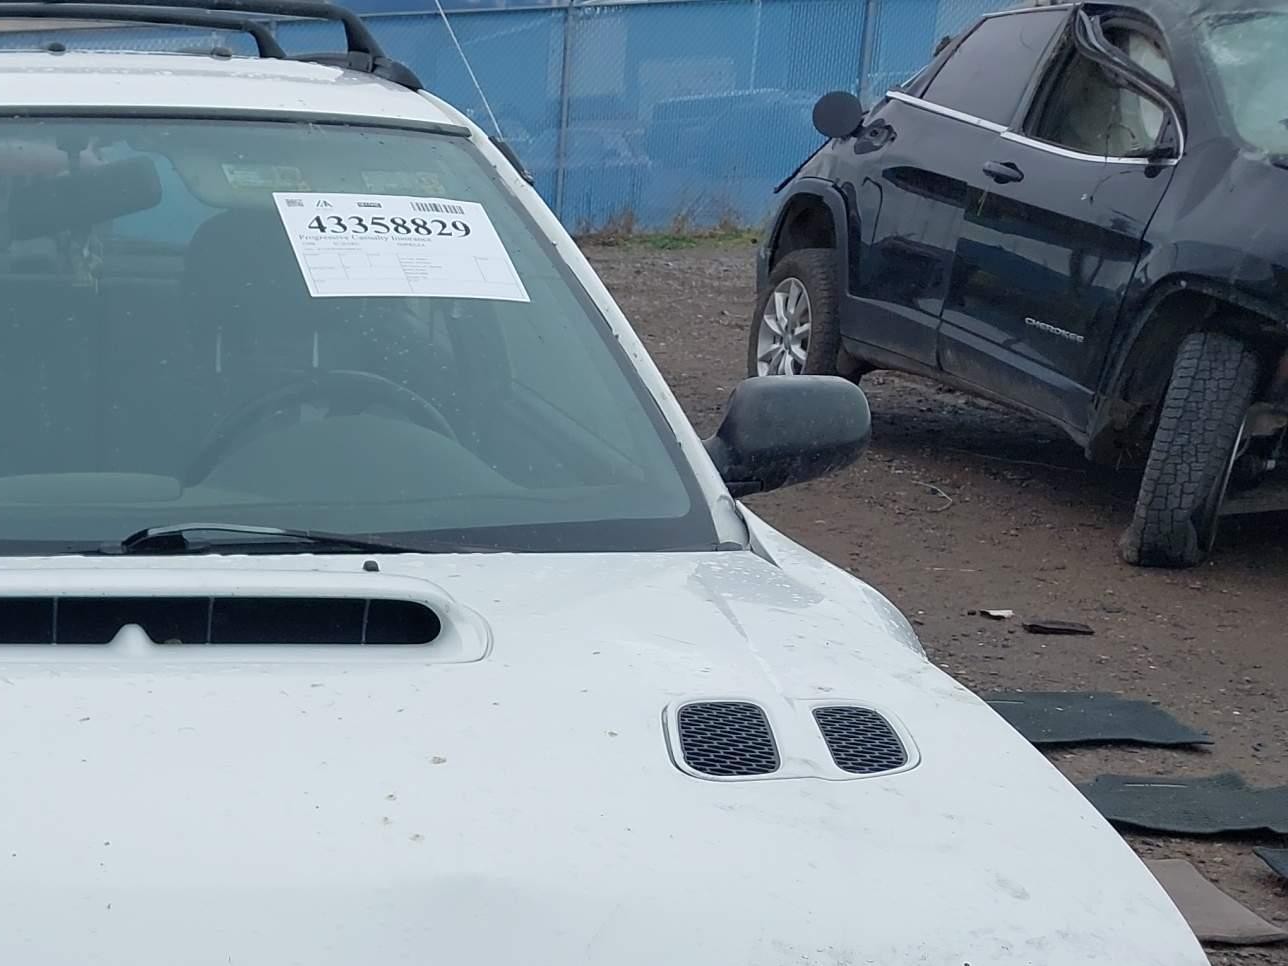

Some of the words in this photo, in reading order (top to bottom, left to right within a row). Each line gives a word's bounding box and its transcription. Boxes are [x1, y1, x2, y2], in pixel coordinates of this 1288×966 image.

[298, 233, 350, 242] Progressive
[351, 233, 389, 243] Casualty
[307, 215, 471, 238] 43358829
[1025, 317, 1085, 342] CHEROKEE
